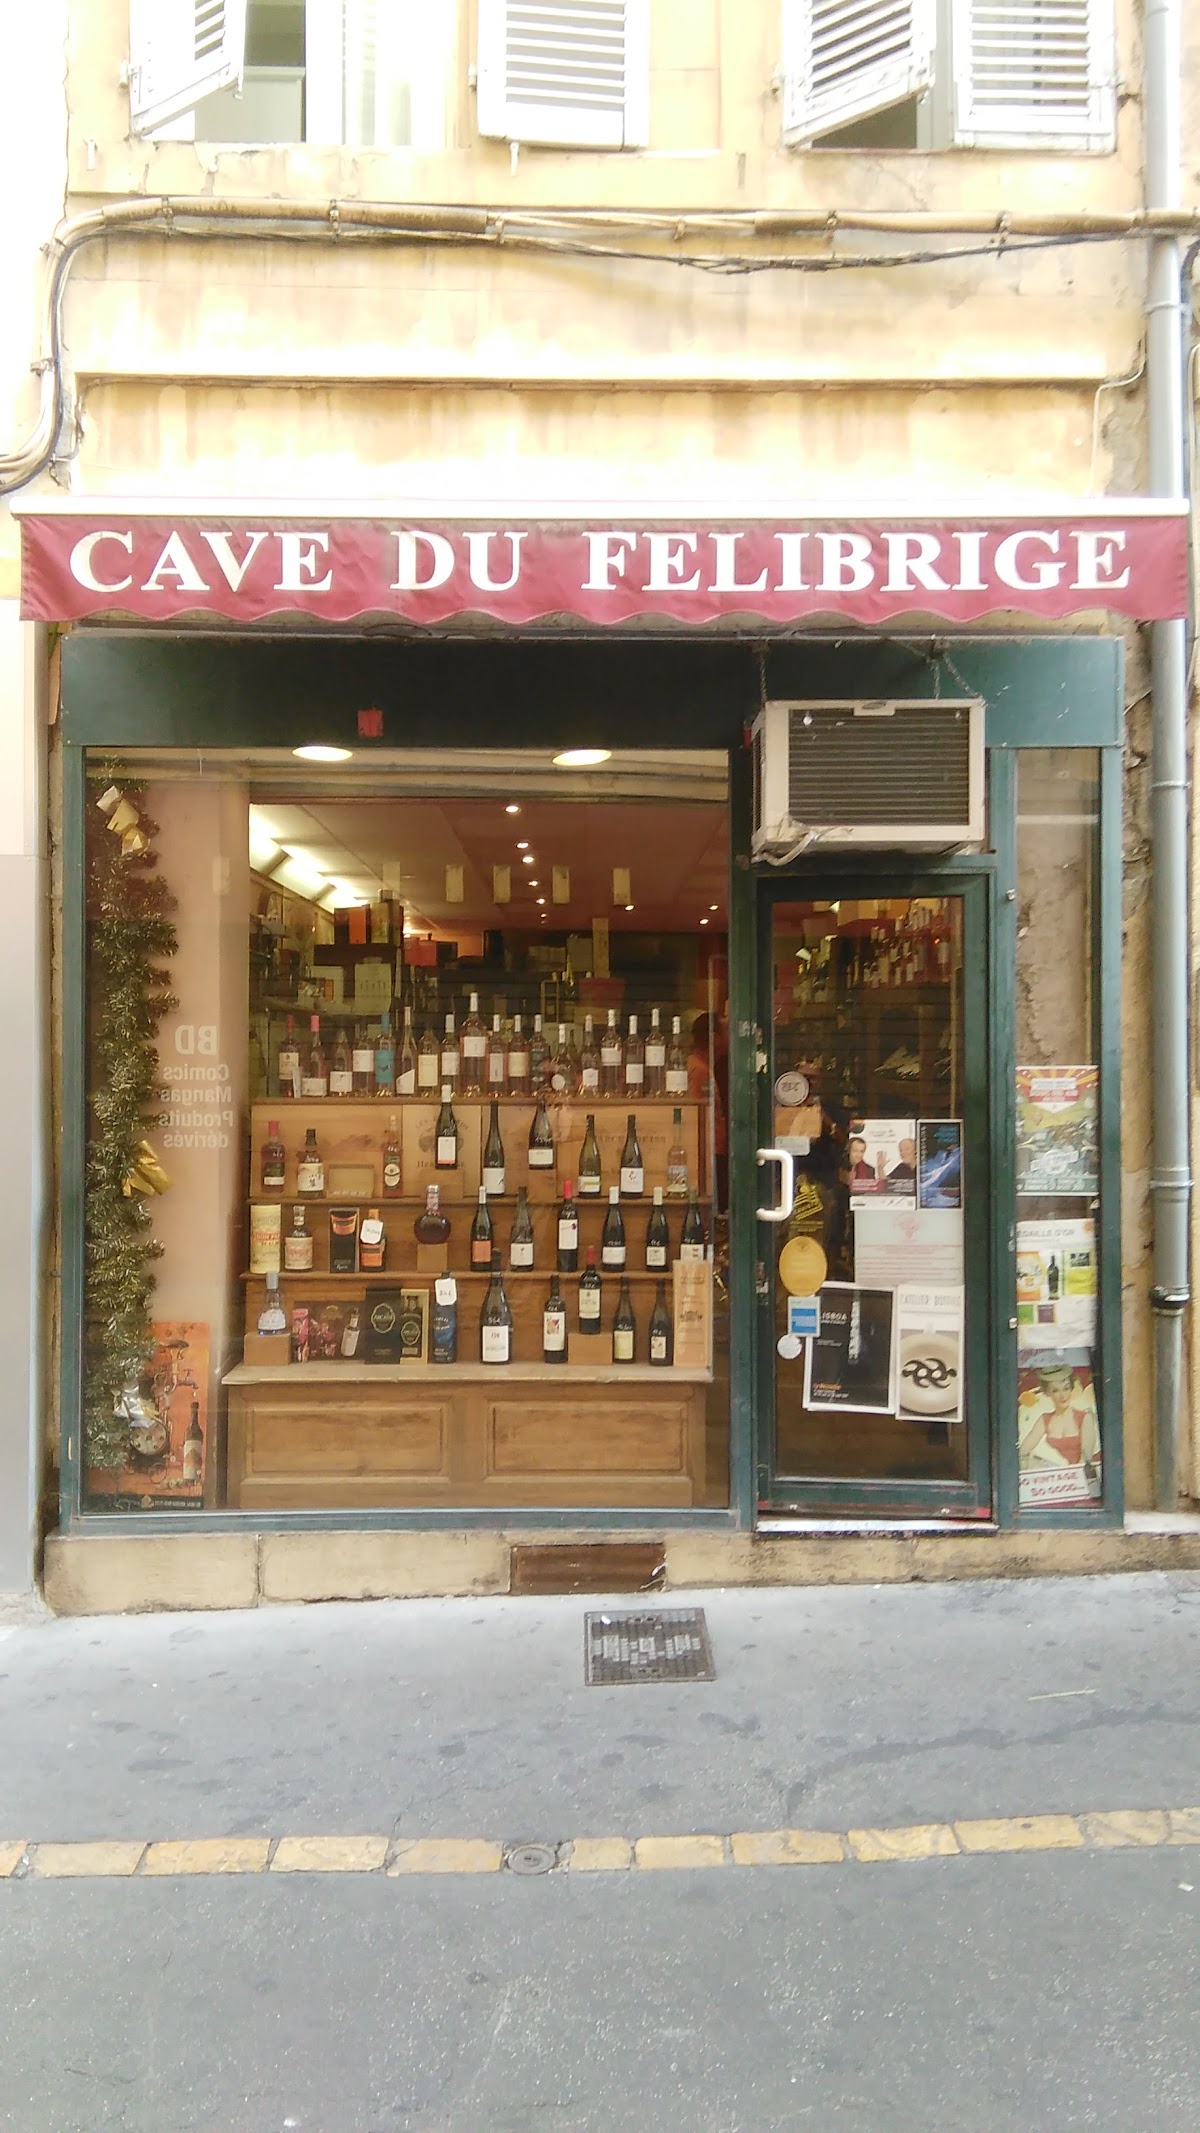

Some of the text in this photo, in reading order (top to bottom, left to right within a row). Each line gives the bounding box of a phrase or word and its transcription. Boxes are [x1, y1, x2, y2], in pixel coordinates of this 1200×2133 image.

[68, 530, 1131, 593] CAVE DU FELIBRIGE
[1034, 1473, 1079, 1486] VINTAGE
[1030, 1486, 1047, 1498] SO
